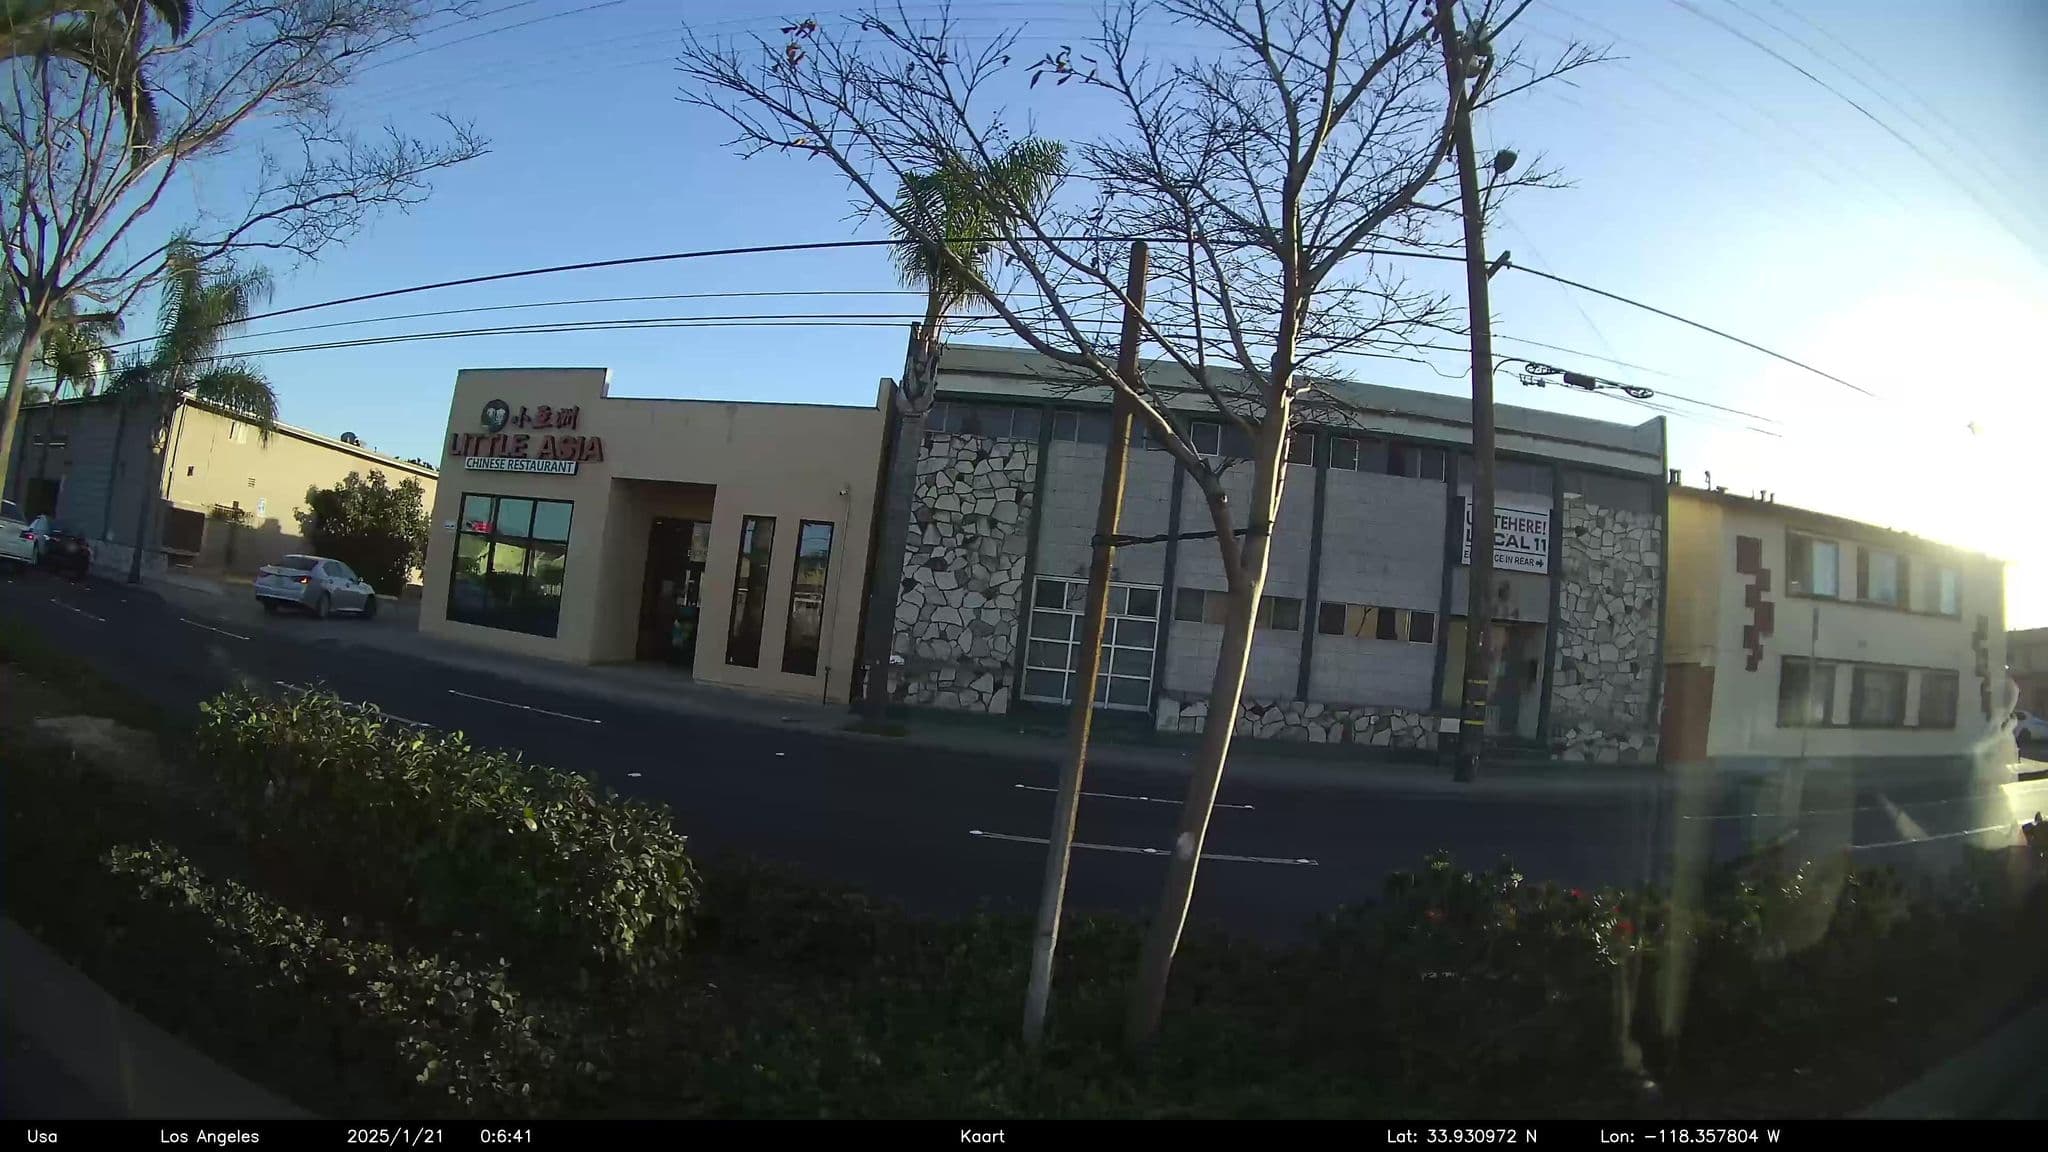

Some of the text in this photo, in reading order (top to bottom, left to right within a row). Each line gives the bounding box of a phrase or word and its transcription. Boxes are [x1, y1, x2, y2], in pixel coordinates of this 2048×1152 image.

[449, 433, 604, 462] LITTLE ASIA
[466, 457, 574, 473] CHINESE RESTAURANT
[1534, 538, 1546, 552] 11
[1505, 555, 1513, 564] IN
[1514, 556, 1535, 567] REAR
